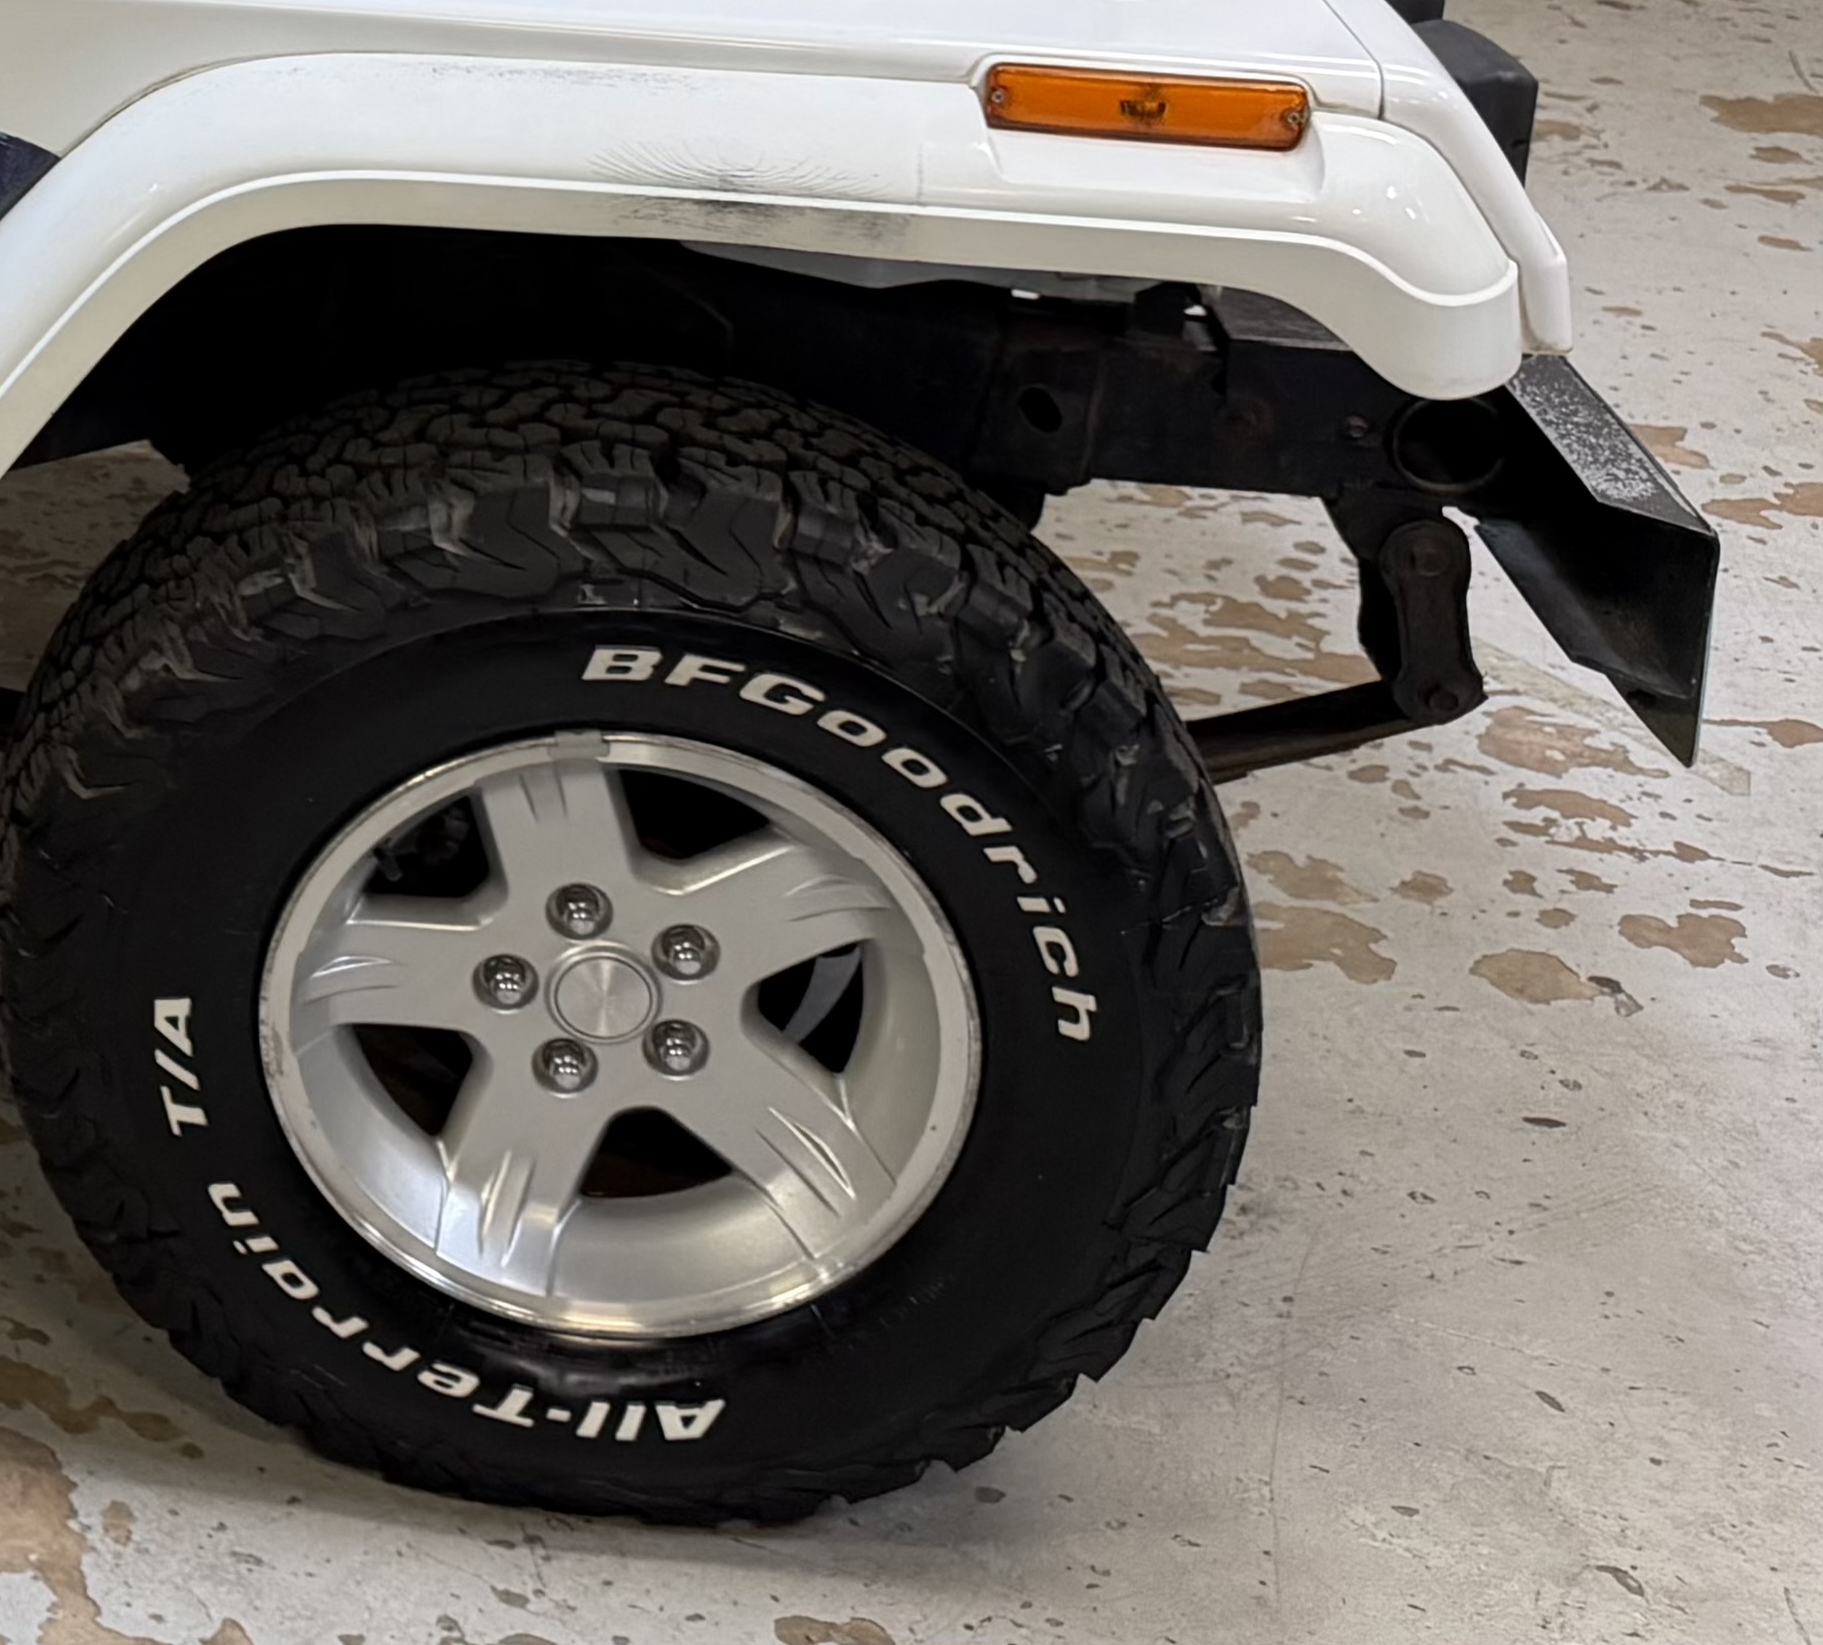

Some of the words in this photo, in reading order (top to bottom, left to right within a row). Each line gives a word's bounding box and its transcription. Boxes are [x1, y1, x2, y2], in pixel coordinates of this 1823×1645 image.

[582, 645, 1098, 1041] BFGoodrich
[153, 997, 208, 1137] T/A
[207, 1182, 725, 1442] All-Terrain
